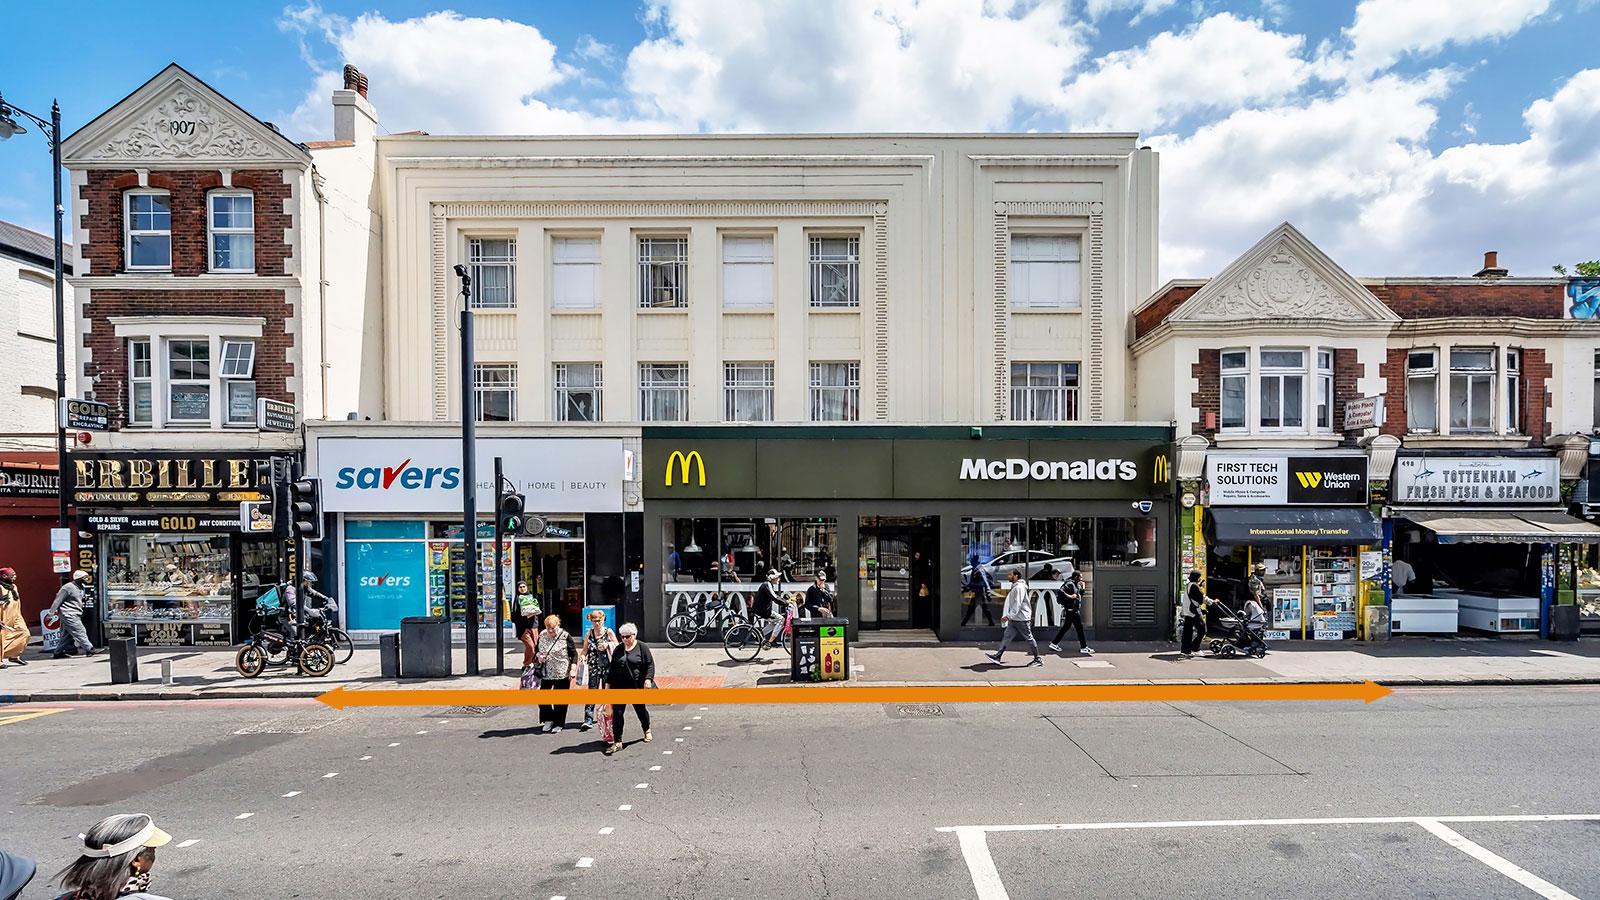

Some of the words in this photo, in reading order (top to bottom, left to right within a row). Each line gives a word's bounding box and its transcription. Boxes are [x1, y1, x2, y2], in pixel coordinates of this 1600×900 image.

[170, 121, 195, 136] 1907
[69, 402, 107, 416] GOLD
[73, 421, 104, 429] ENGRAVING
[959, 458, 1138, 481] McDonald's
[1217, 463, 1247, 473] FIRST
[1250, 463, 1278, 473] TECH
[335, 458, 461, 490] savers
[1323, 472, 1360, 481] Western
[1442, 470, 1516, 483] TOTTENHAM
[1217, 475, 1278, 485] SOLUTIONS
[1323, 481, 1350, 489] Union
[527, 481, 556, 490] HOME
[570, 481, 607, 490] BEAUTY
[1407, 485, 1446, 498] FRESH
[1451, 485, 1480, 498] FISH
[1485, 485, 1493, 498] &
[1498, 485, 1554, 499] SEAFOOD
[160, 517, 196, 531] GOLD
[1295, 528, 1318, 536] Money
[360, 572, 411, 587] savers
[163, 623, 183, 631] BUY
[150, 630, 178, 639] GOLD
